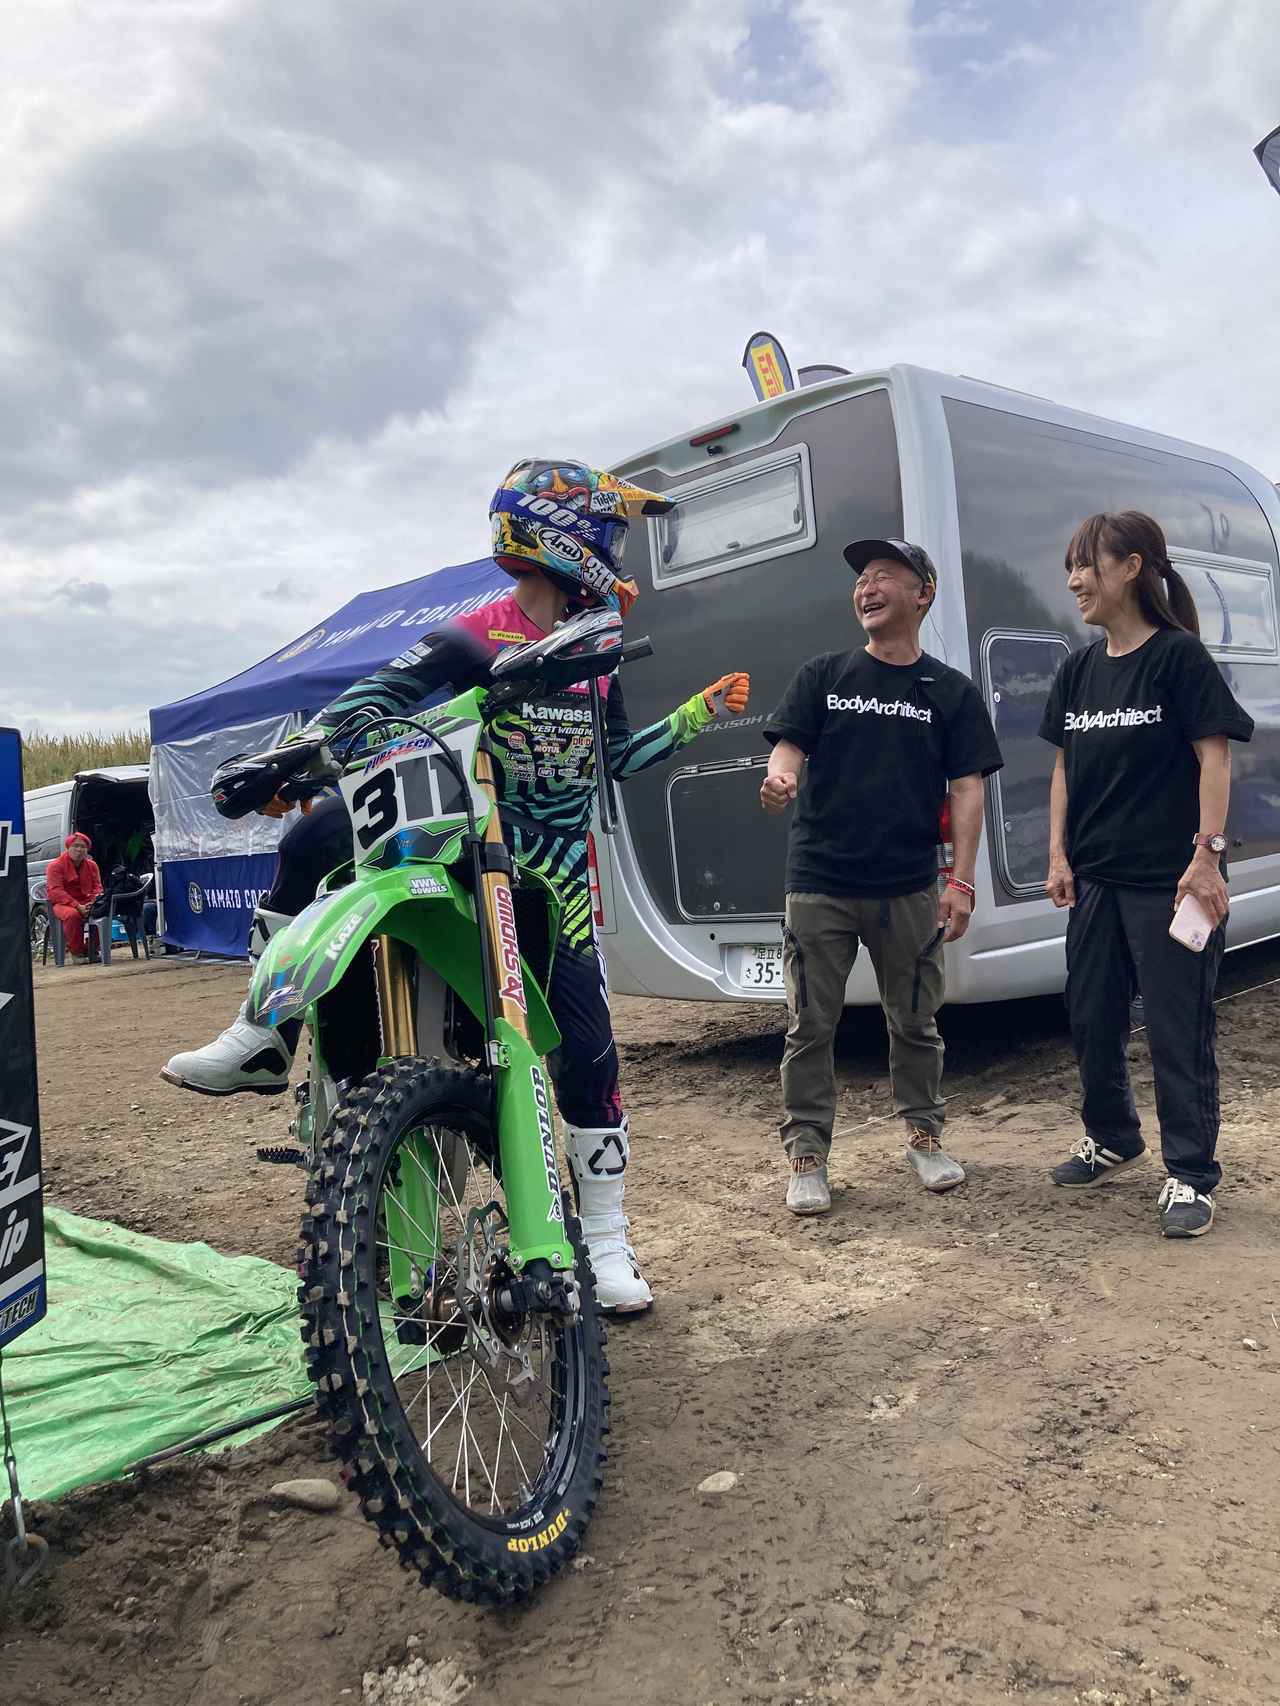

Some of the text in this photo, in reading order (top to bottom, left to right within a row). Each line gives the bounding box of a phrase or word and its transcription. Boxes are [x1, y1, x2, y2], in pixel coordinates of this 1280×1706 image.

[515, 493, 601, 542] 100%
[541, 532, 582, 560] Arai
[522, 702, 593, 723] Kawasa
[827, 694, 932, 724] BodyArchitect
[353, 750, 468, 849] 311
[204, 889, 242, 909] YAMATO
[754, 962, 784, 984] 35-
[530, 1065, 562, 1193] DUNLOP
[507, 1510, 569, 1553] DUNLOP
